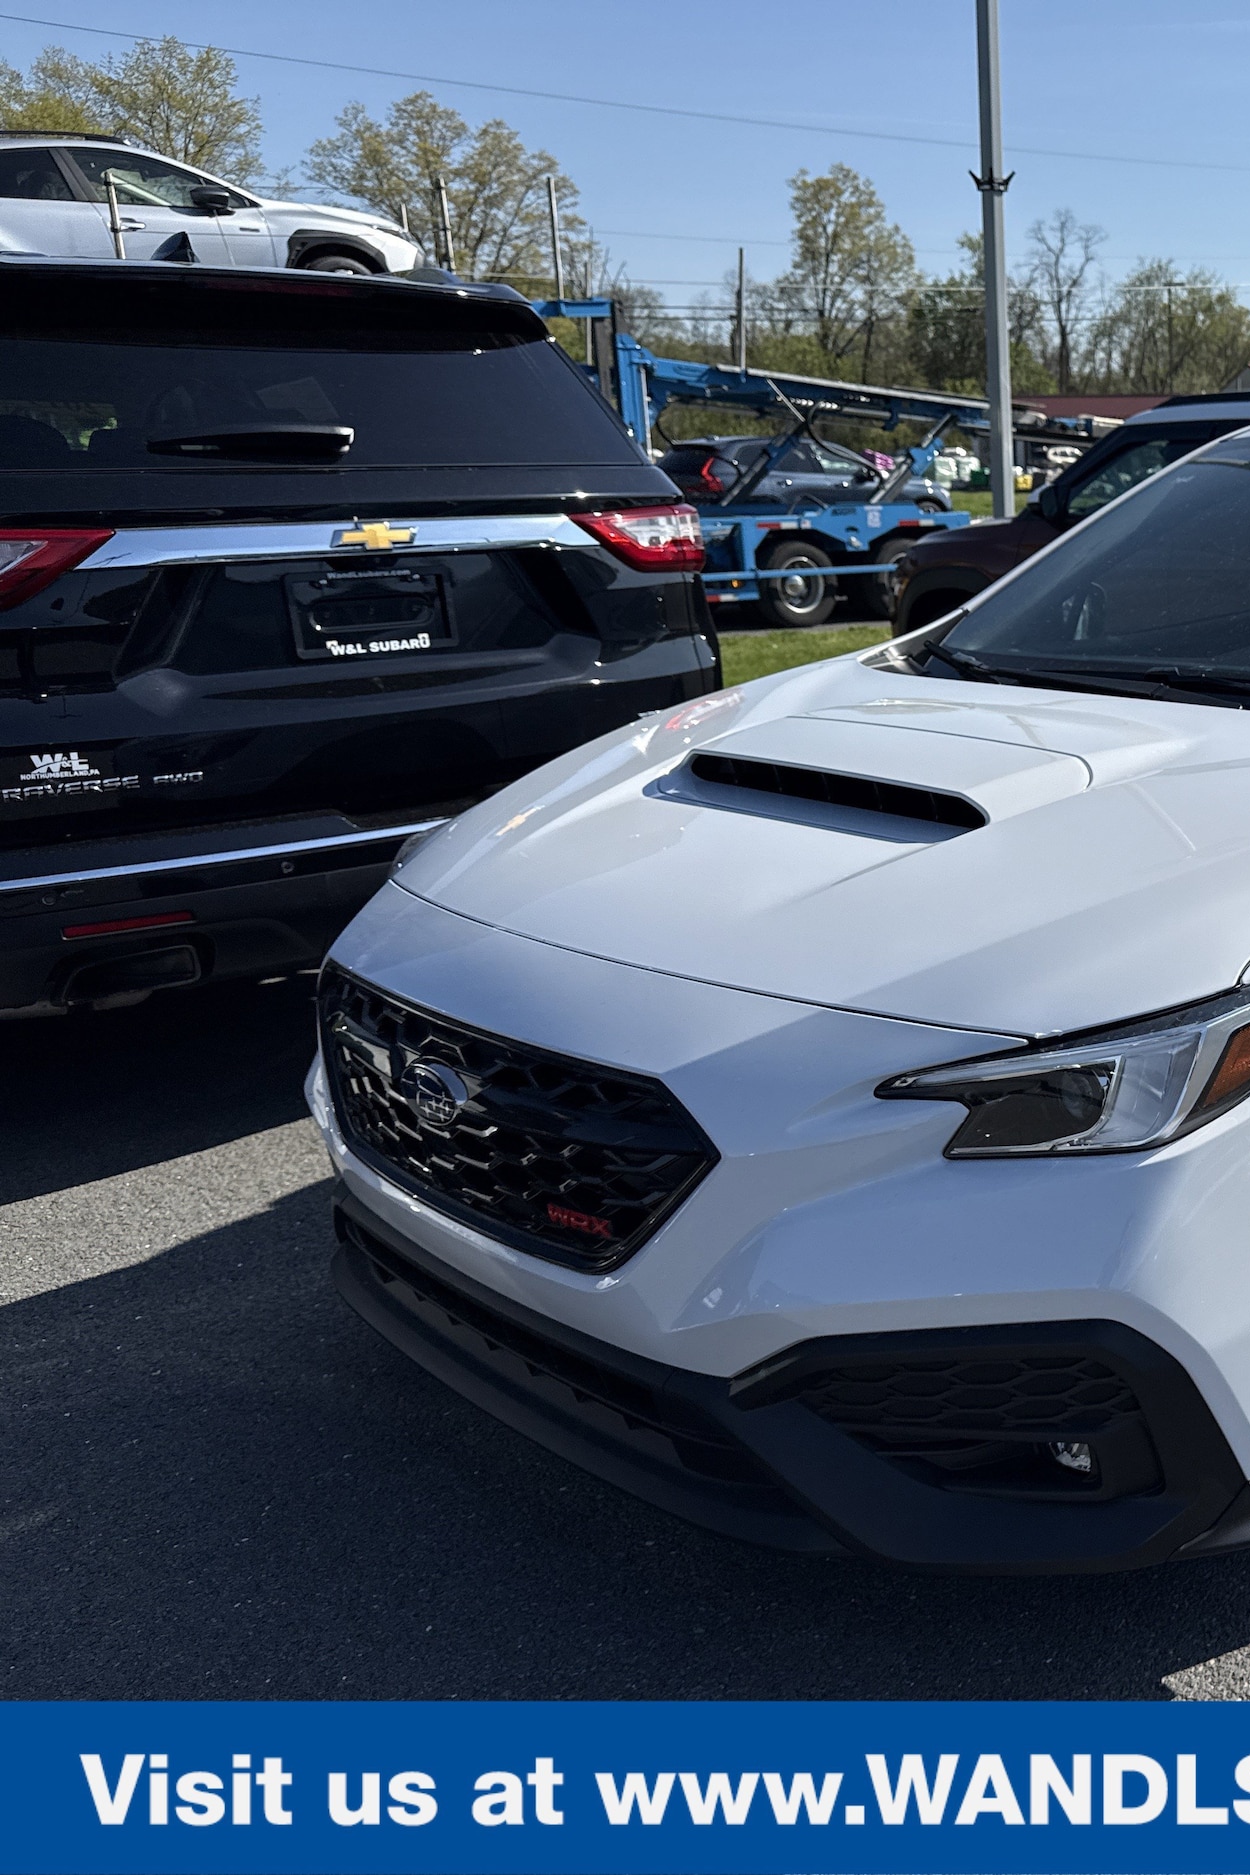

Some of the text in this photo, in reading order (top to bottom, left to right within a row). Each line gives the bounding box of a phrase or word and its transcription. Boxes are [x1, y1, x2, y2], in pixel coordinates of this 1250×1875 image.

[330, 637, 430, 656] W&L SUBARU
[30, 752, 90, 774] W&L
